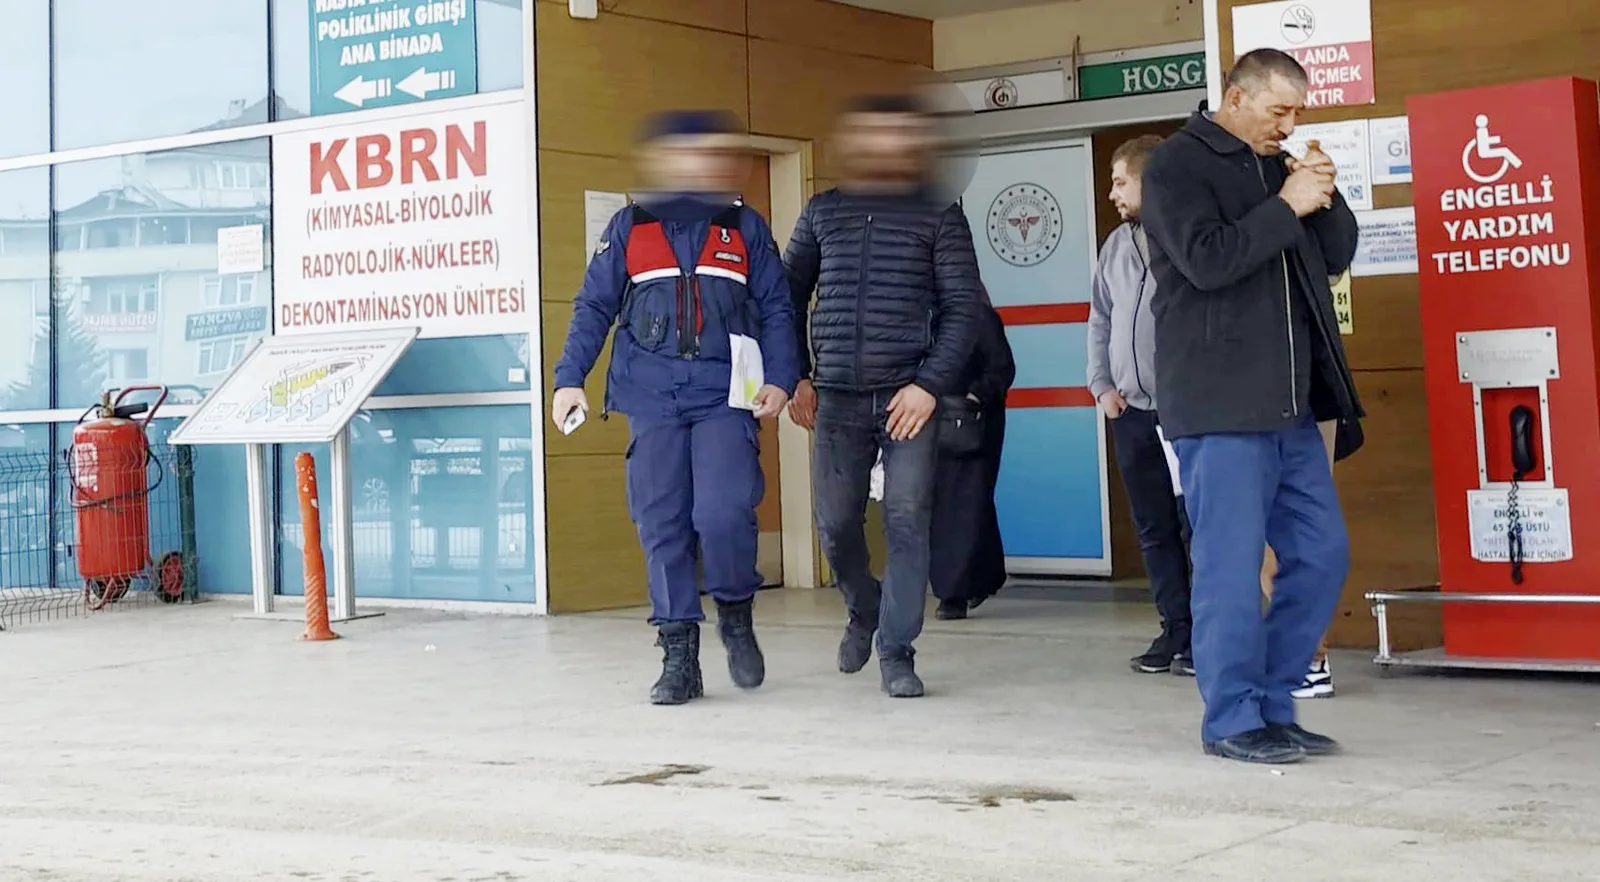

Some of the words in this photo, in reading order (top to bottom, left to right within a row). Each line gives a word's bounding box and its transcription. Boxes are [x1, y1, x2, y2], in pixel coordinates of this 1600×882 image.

[318, 4, 411, 41] POLİKLİNİK
[340, 42, 376, 66] ANA
[379, 33, 444, 61] BİNADA
[1310, 63, 1362, 88] İÇMEK
[1304, 87, 1345, 107] KTIR
[309, 120, 487, 195] KBRN
[1440, 174, 1554, 211] ENGELLİ
[306, 184, 493, 239] (KİMYASAL-BİYOLOJİK
[1443, 212, 1554, 242] YARDIM
[302, 237, 500, 280] RADYOLOJİK-NÜKLEER)
[1431, 242, 1571, 274] TELEFONU
[281, 290, 448, 328] DEKONTAMİNASYON
[453, 280, 526, 316] ÜNİTESİ
